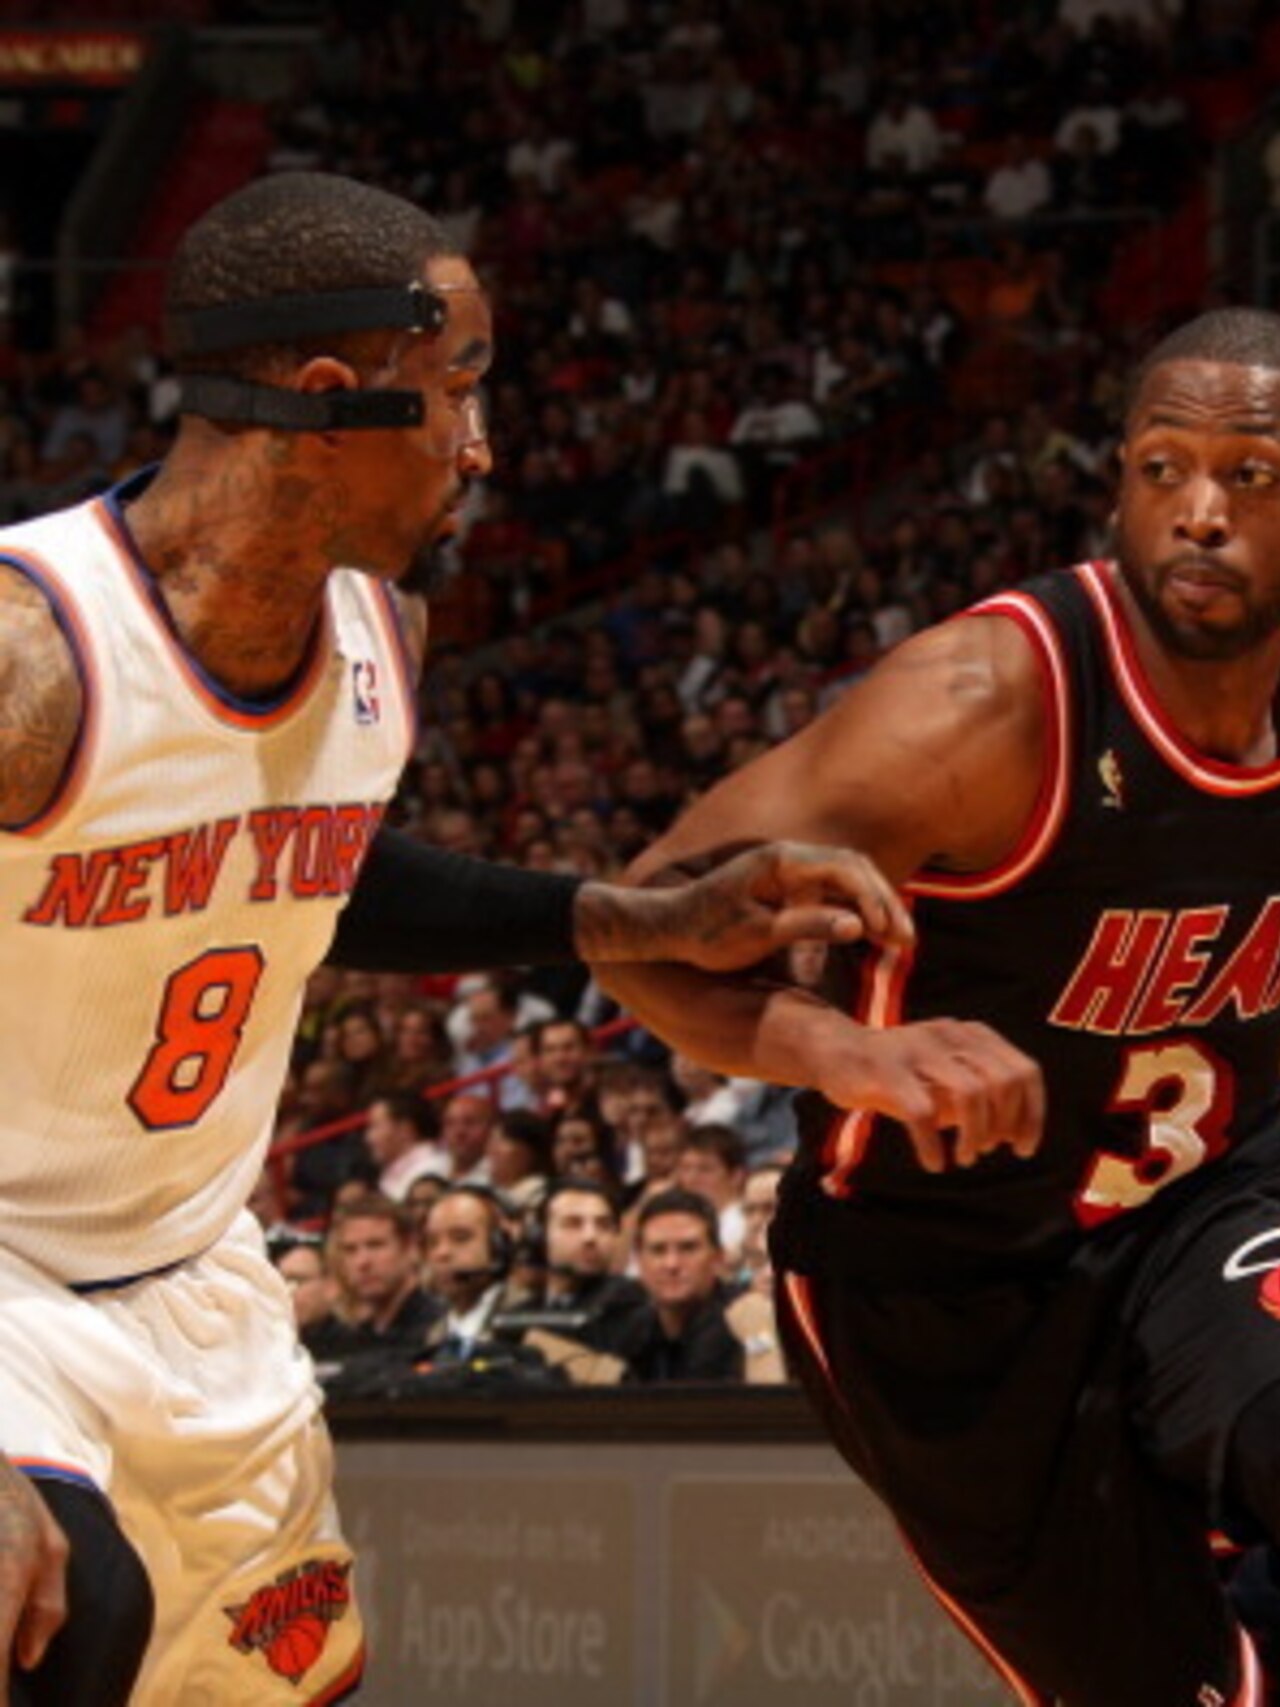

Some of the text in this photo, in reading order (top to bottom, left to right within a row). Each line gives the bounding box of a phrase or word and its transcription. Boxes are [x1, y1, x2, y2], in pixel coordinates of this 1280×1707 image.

[23, 817, 239, 927] NEW
[125, 944, 266, 1132] 8
[1072, 1038, 1235, 1228] 3
[228, 1558, 350, 1648] KNICKS
[401, 1582, 608, 1691] App Store
[762, 1586, 924, 1707] Google
